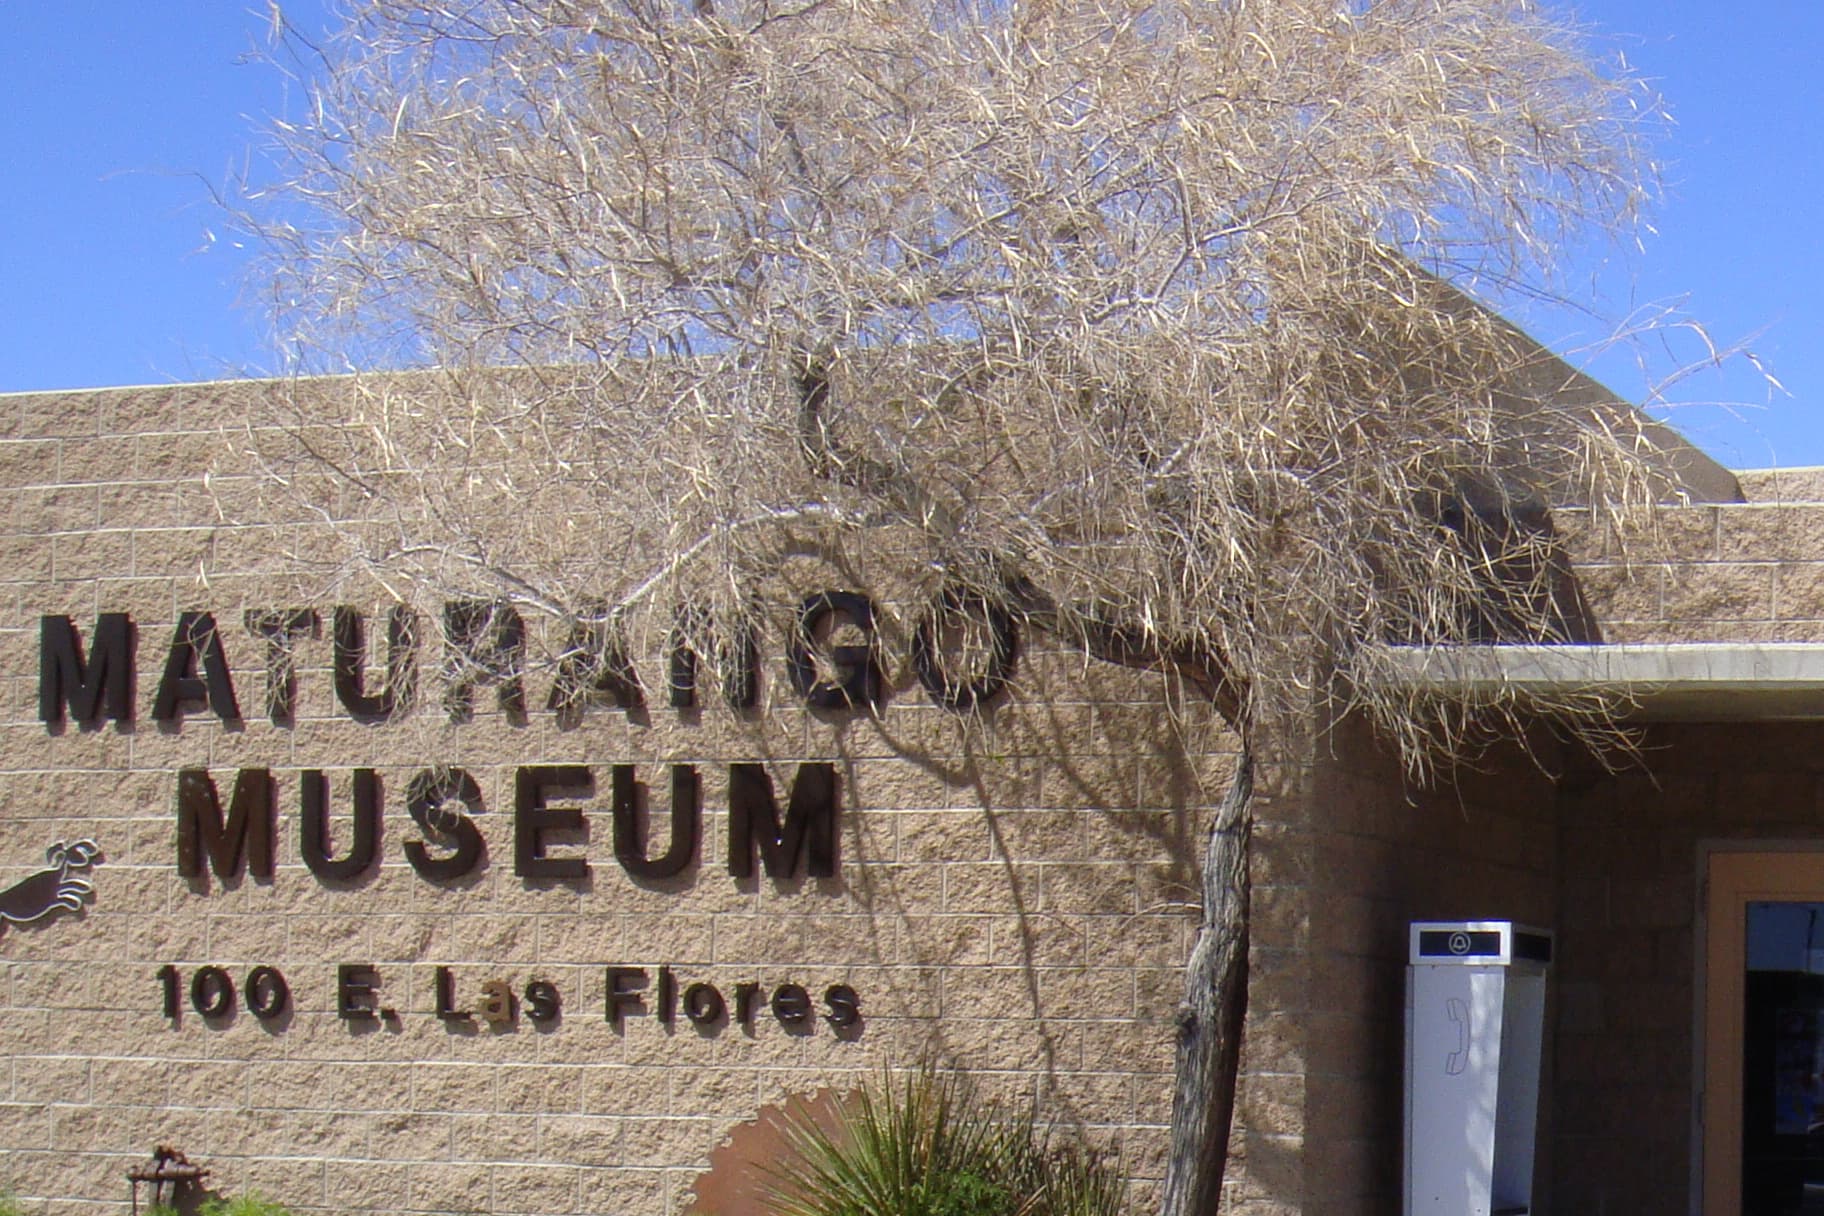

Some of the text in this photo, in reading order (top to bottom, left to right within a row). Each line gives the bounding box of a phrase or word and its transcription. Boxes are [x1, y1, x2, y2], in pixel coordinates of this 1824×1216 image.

[177, 762, 836, 880] MUSEUM
[157, 965, 860, 1025] 100 E. Las Flores
